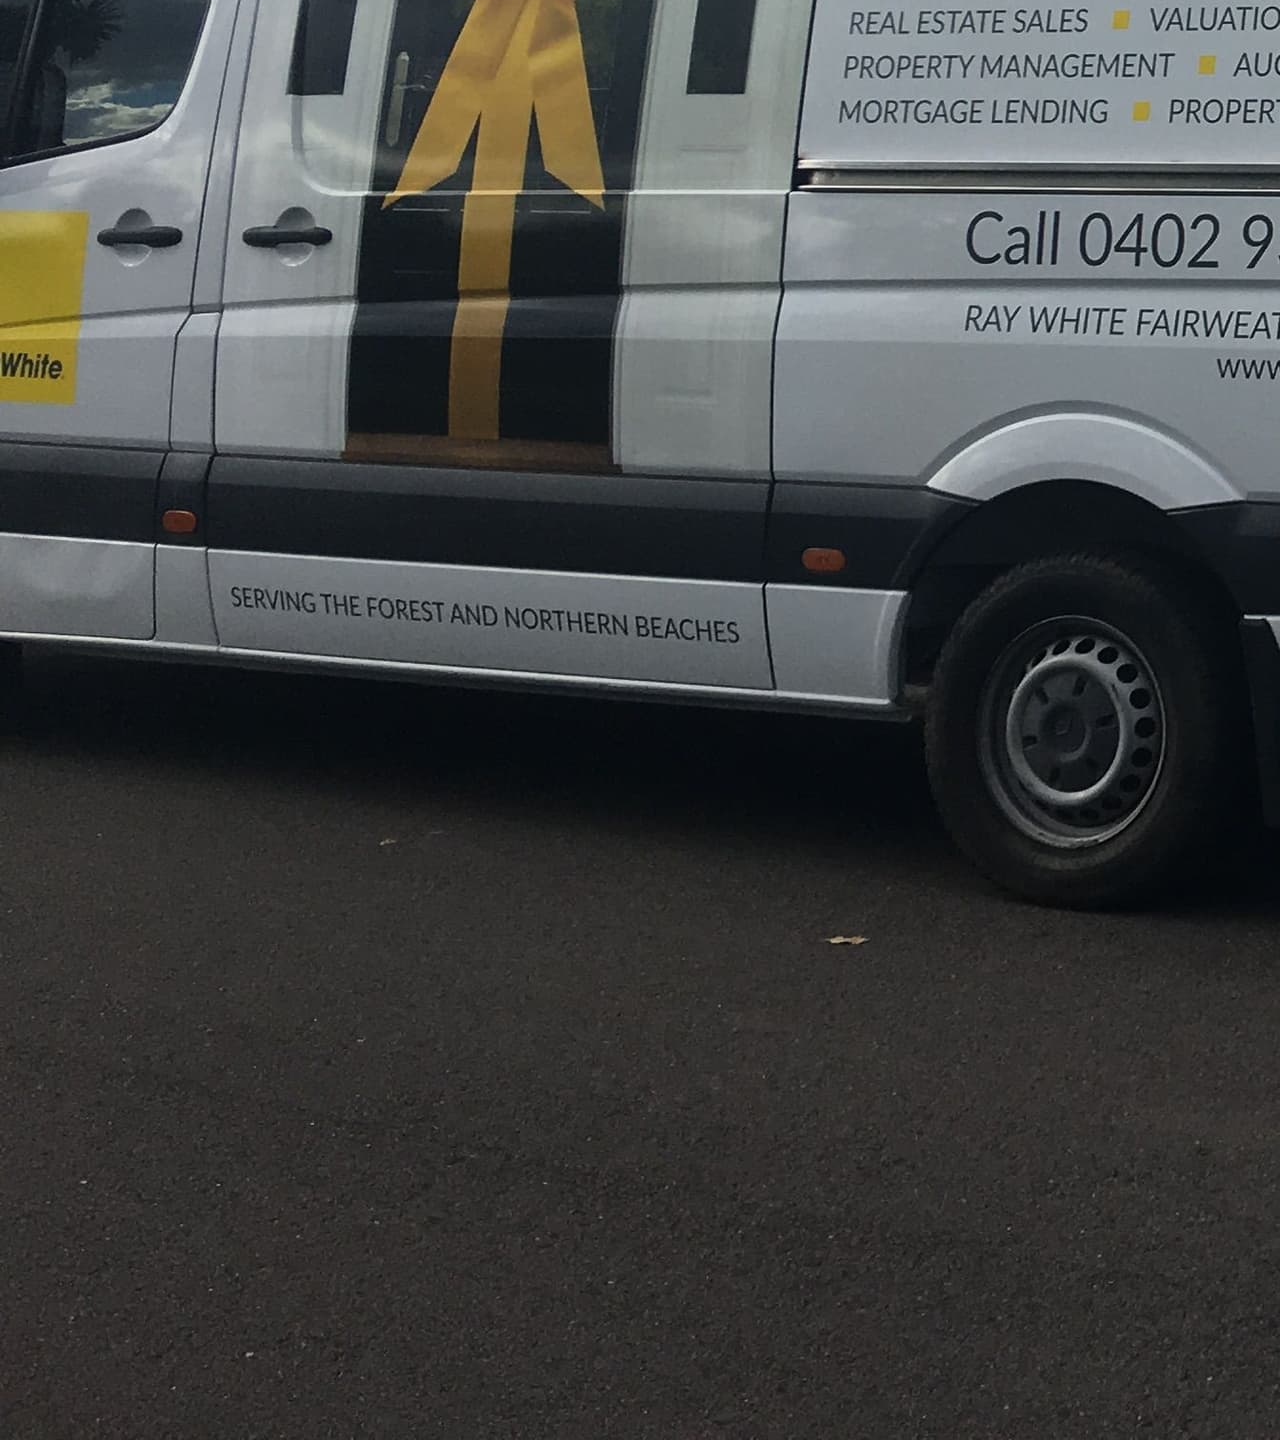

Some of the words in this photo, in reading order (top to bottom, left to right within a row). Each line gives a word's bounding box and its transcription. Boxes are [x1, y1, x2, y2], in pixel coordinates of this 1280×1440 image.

[848, 10, 911, 36] REAL
[916, 9, 1007, 36] ESTATE
[1011, 8, 1089, 35] SALES
[843, 54, 976, 80] PROPERTY
[979, 52, 1177, 79] MANAGEMENT
[838, 99, 986, 125] MORTGAGE
[989, 98, 1109, 125] LENDING
[965, 209, 1062, 266] Call
[1078, 211, 1221, 269] 0402
[964, 303, 1023, 333] RAY
[1028, 305, 1128, 336] WHITE
[1, 351, 63, 380] White
[230, 586, 316, 614] SERVING
[319, 593, 363, 617] THE
[366, 596, 445, 623] FOREST
[449, 603, 499, 627] AND
[503, 606, 630, 637] NORTHERN
[634, 614, 740, 644] BEACHES
